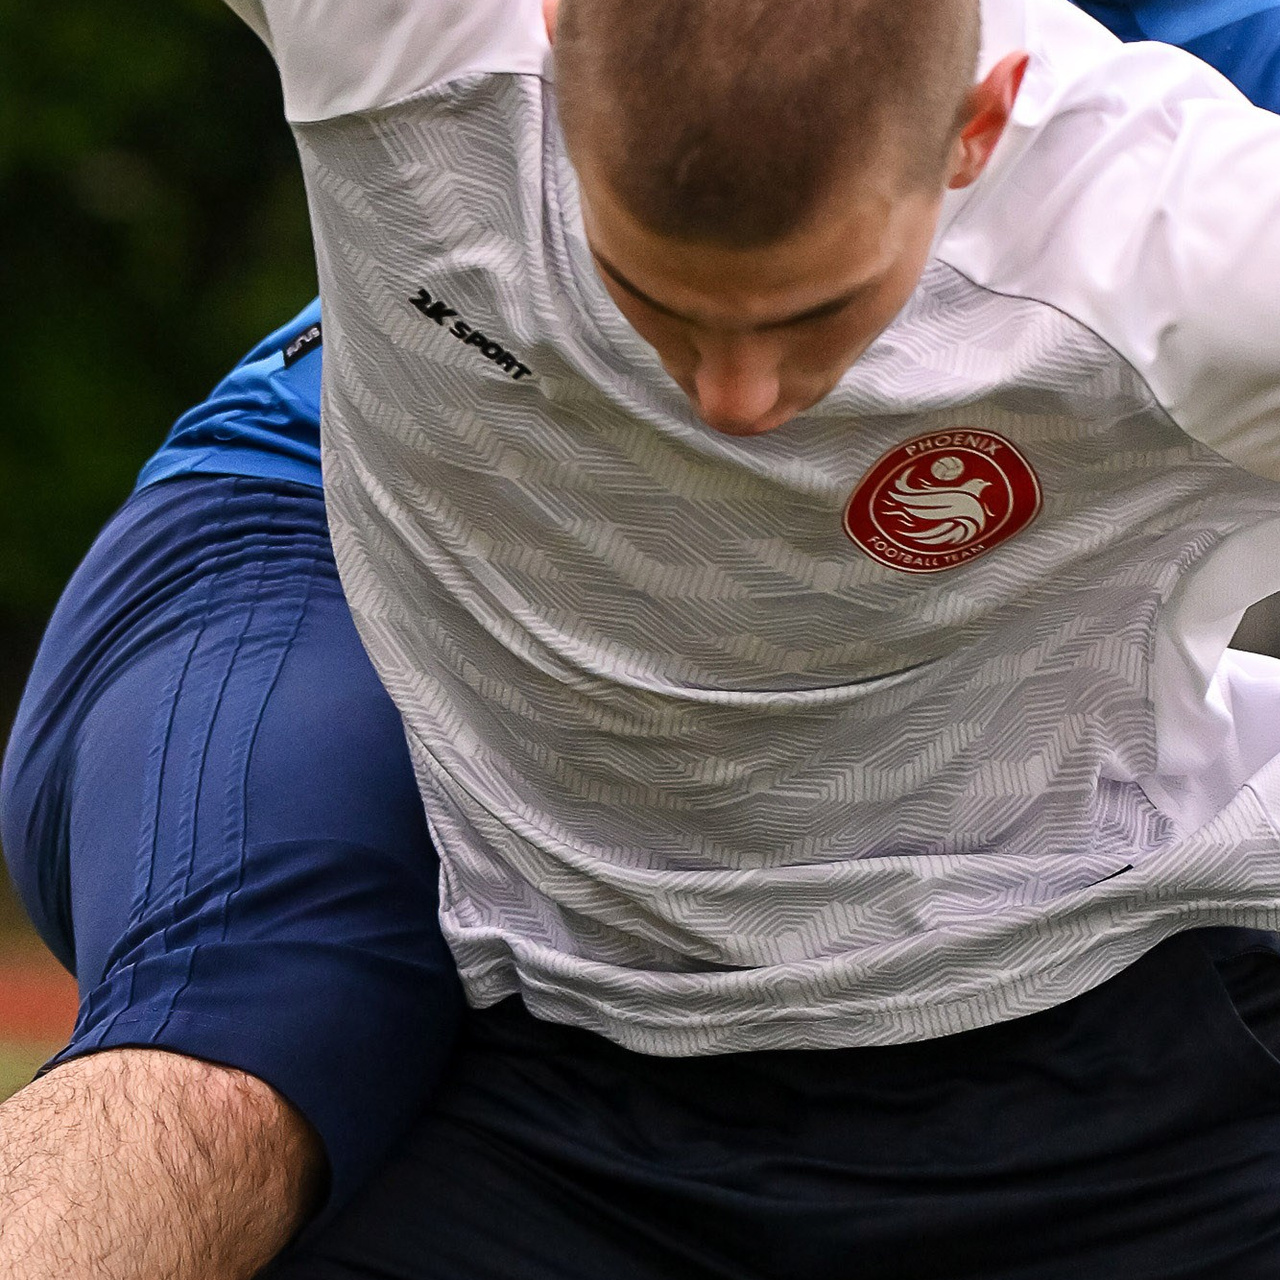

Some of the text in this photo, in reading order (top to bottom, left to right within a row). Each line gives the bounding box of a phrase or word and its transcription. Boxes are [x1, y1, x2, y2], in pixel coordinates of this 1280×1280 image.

[449, 321, 533, 380] SPORT
[905, 432, 1004, 457] PHOENIX
[867, 535, 986, 567] FOOTBALL TEAM
